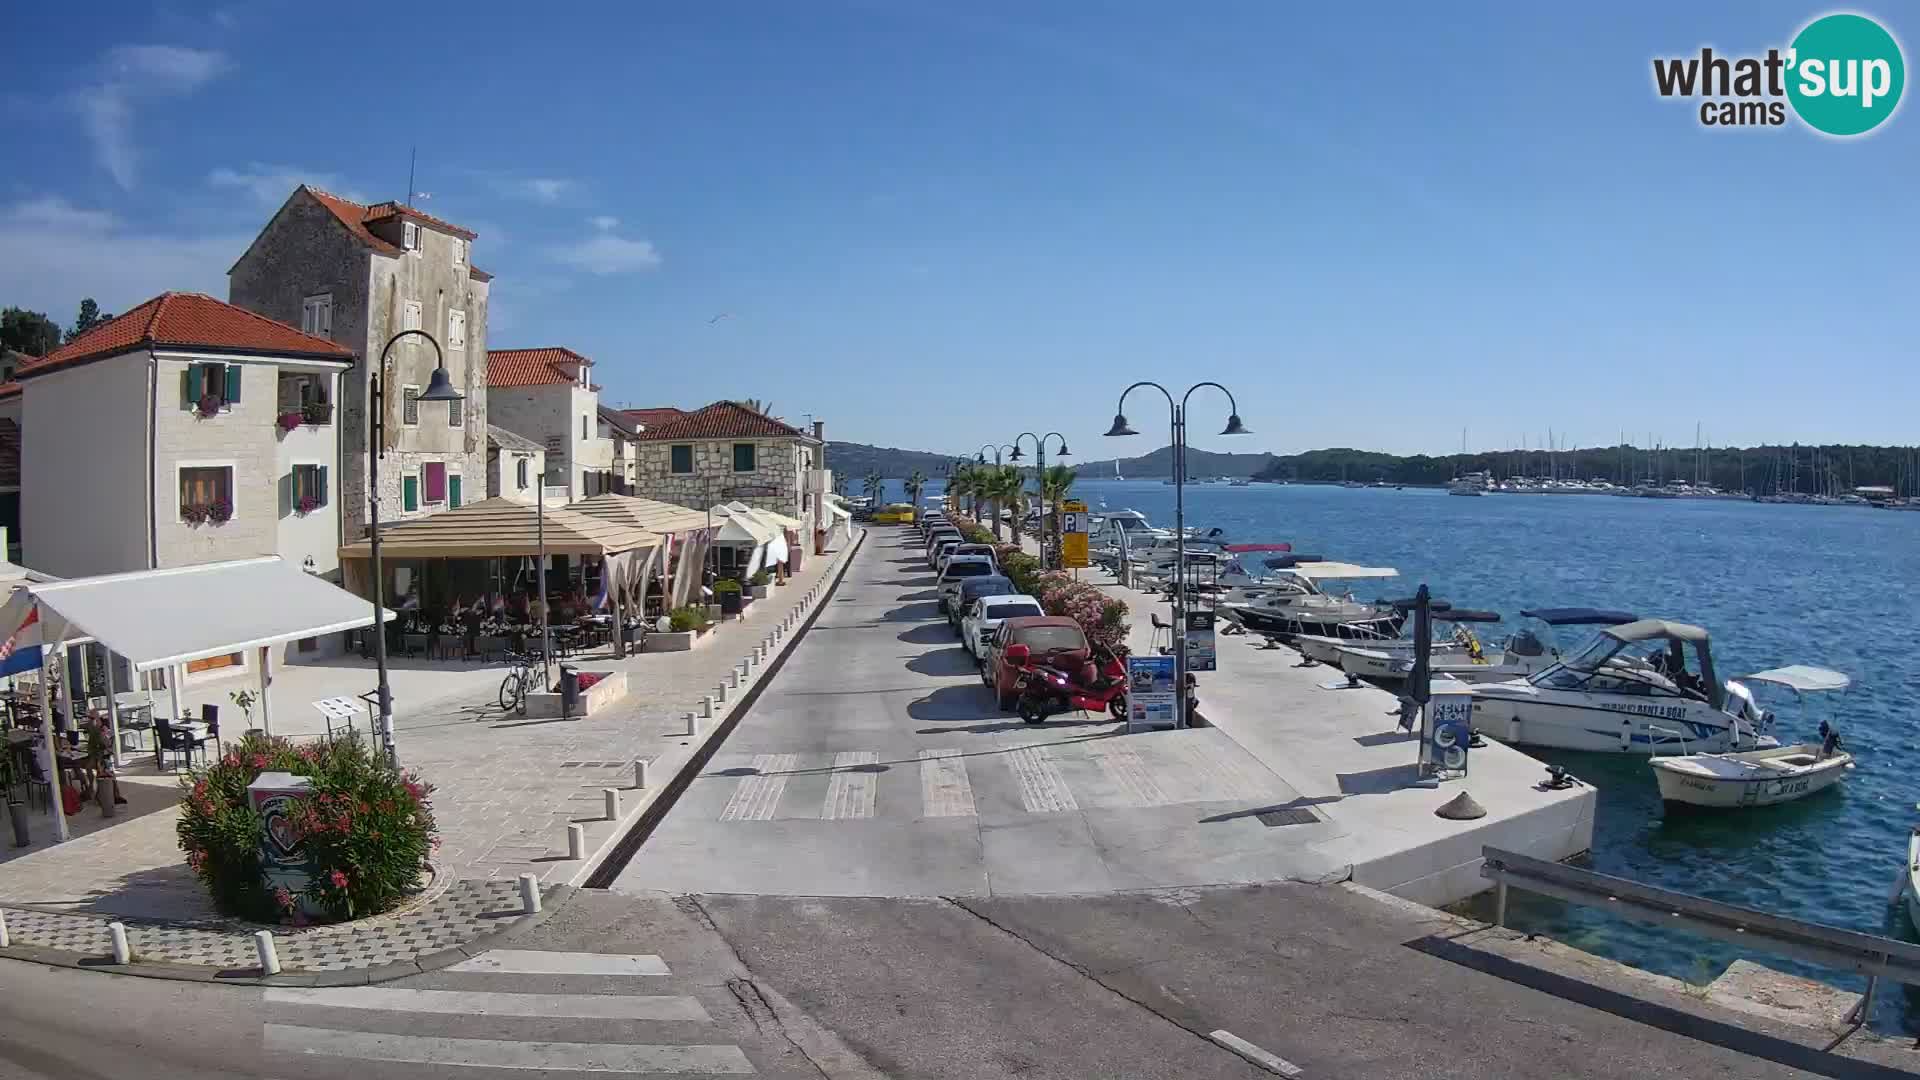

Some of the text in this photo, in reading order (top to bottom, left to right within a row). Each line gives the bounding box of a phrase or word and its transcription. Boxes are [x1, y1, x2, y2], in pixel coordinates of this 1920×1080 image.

[1064, 514, 1075, 531] P
[1435, 703, 1469, 713] RENT
[1637, 704, 1658, 716] RENT
[1666, 706, 1687, 719] BOAT
[1434, 712, 1442, 721] A
